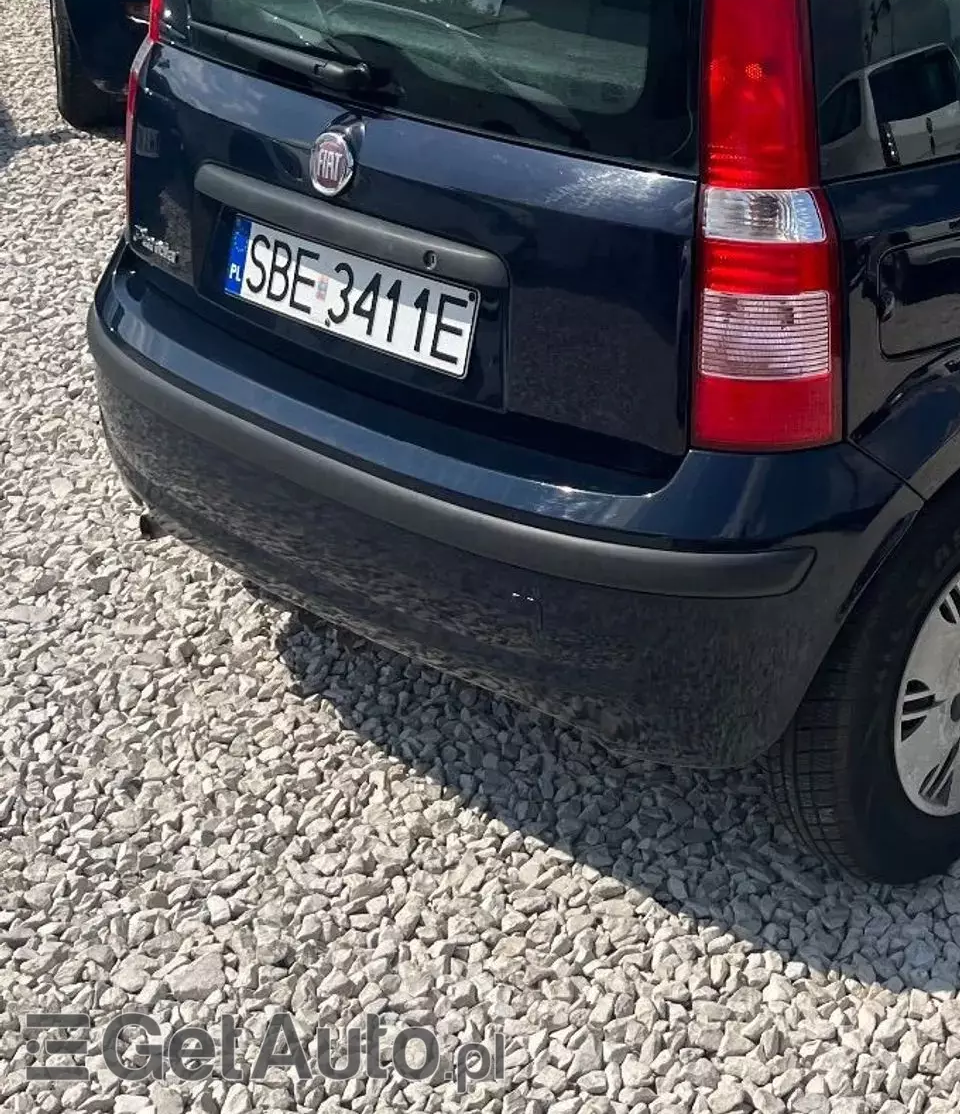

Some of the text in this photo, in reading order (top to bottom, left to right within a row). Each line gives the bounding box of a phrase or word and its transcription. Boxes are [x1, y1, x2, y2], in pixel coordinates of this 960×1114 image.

[317, 147, 343, 181] FIAT
[228, 264, 241, 282] PL
[245, 234, 469, 365] SBE 3411E
